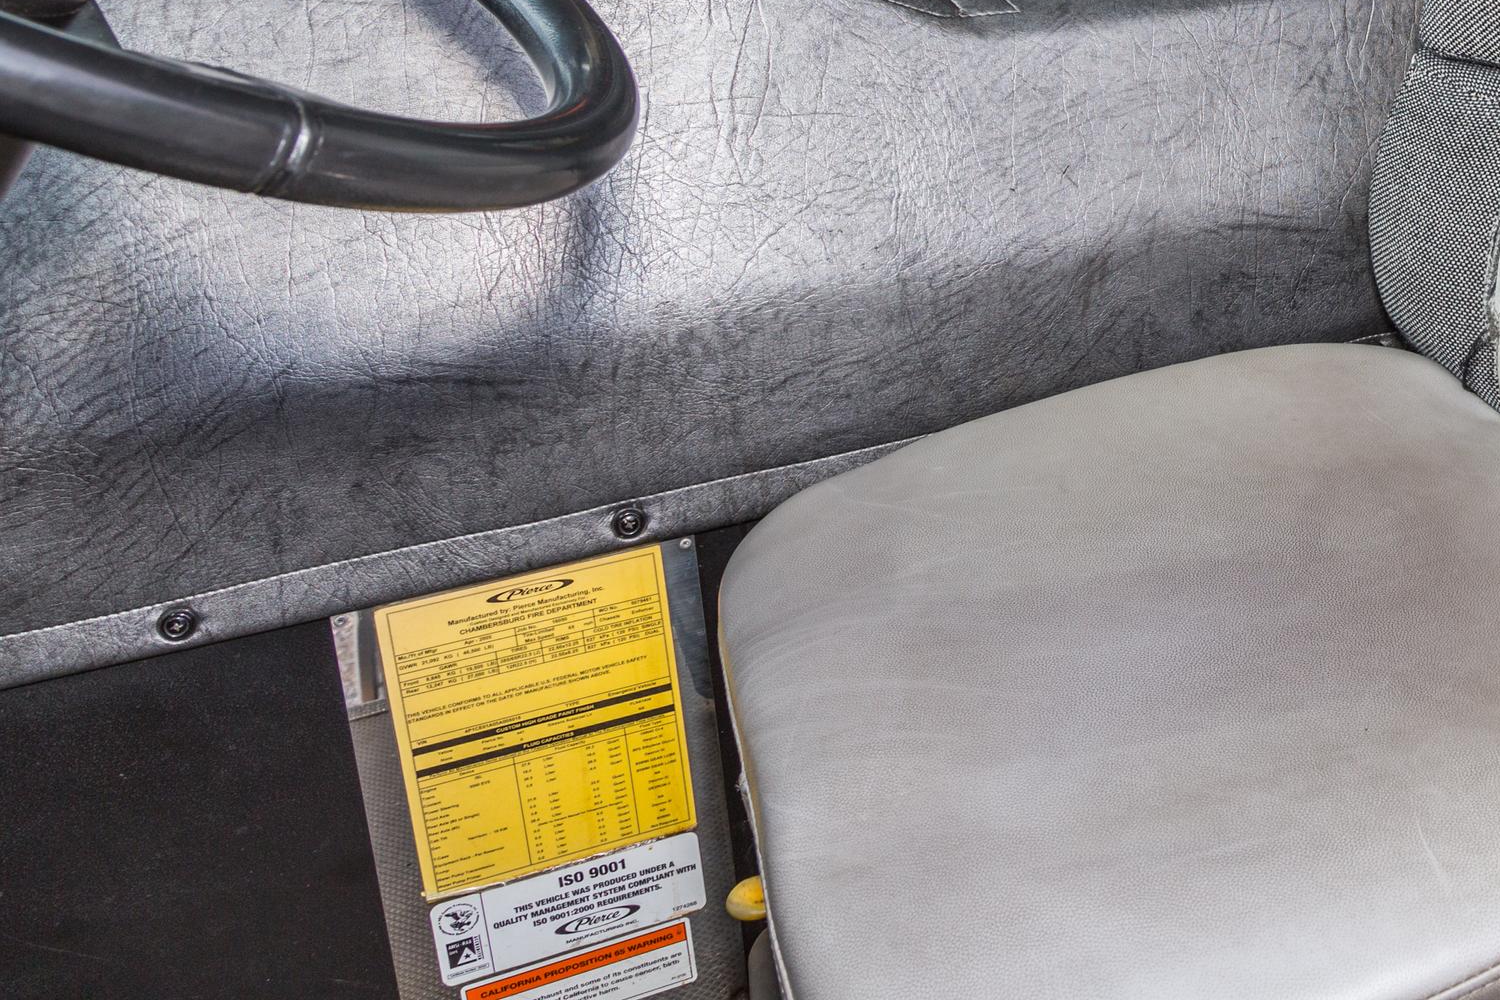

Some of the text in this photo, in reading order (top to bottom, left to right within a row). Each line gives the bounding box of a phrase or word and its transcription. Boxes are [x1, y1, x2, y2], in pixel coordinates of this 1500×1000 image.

[507, 582, 553, 600] Pierce
[447, 609, 497, 626] Manufactured
[512, 600, 535, 611] Pierce
[459, 597, 597, 635] CHAMBERSBURG FIRE DEPARTMENT
[422, 705, 445, 714] VEHICLE
[447, 696, 481, 708] CONFORMS
[504, 681, 538, 694] APPLICABLE
[552, 672, 577, 682] FEDERAL
[601, 660, 623, 669] VEHICLE
[495, 723, 521, 733] CUSTOM
[537, 713, 557, 722] GRADE
[558, 709, 574, 717] PAINT
[575, 704, 594, 712] FINISH
[523, 731, 573, 748] FLUID CAPACITIES
[513, 902, 533, 913] THIS
[535, 891, 569, 906] VEHICLE
[573, 885, 590, 895] WAS
[592, 872, 636, 889] PRODUCED
[639, 863, 666, 876] UNDER
[558, 858, 626, 887] ISO 9001
[493, 863, 696, 929] QUALITY MANAGEMENT SYSTEM COMPLIANT WITH
[533, 883, 662, 926] ISO 9001:2000 REQUIREMENTS.
[566, 923, 623, 944] MANUFACTURING
[574, 910, 620, 931] Pierce
[479, 932, 673, 999] CALIFORNIA PROPOSITION 65 WARNING
[562, 984, 599, 1000] California
[610, 974, 632, 985] cause
[662, 957, 679, 968] birth
[564, 983, 578, 993] and
[580, 977, 600, 988] some
[611, 969, 621, 977] its
[623, 954, 668, 974] constituents
[670, 951, 682, 959] are
